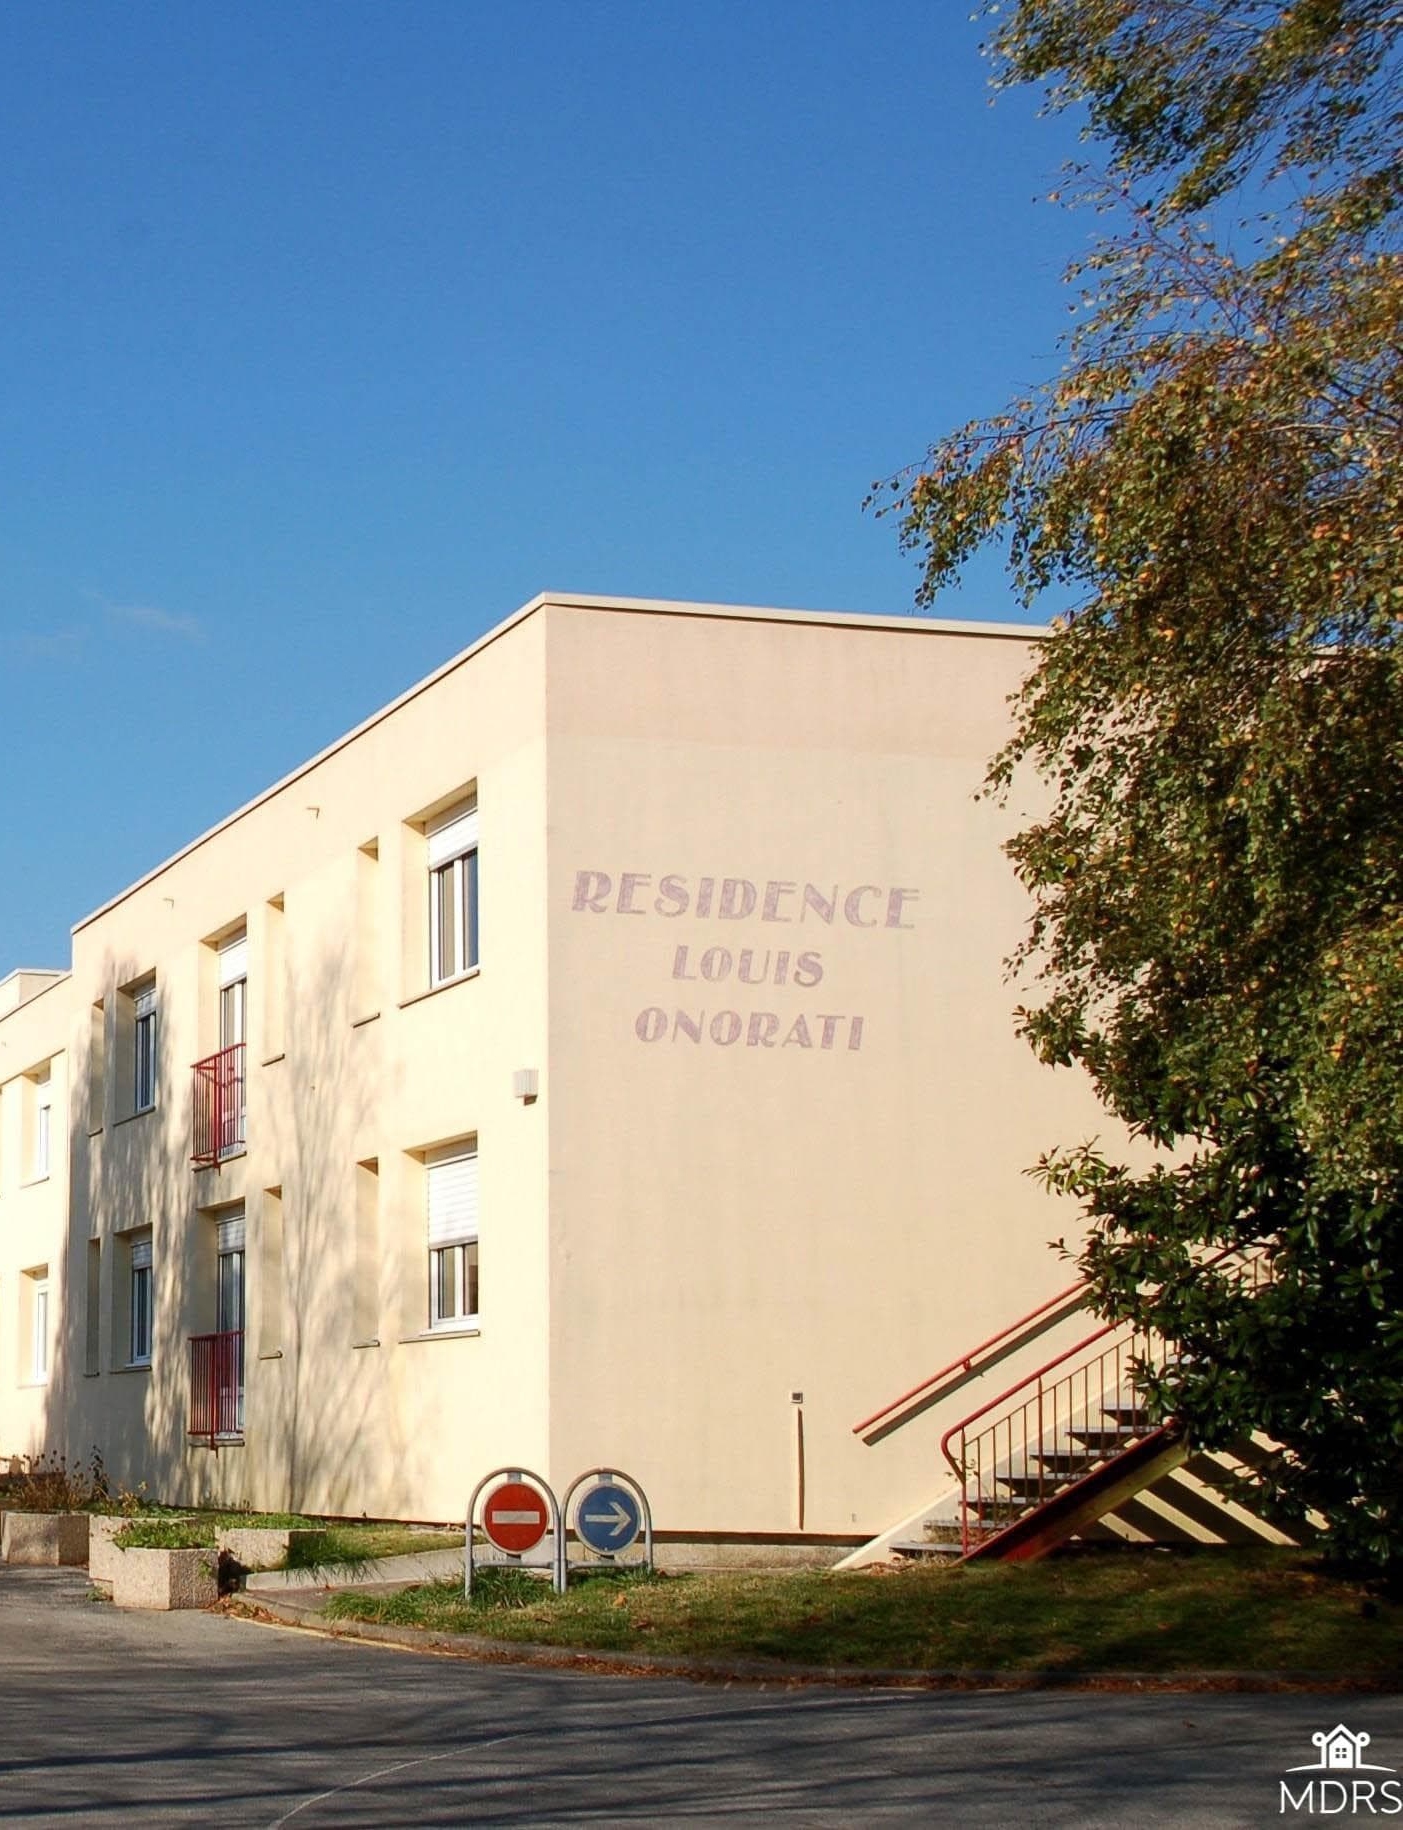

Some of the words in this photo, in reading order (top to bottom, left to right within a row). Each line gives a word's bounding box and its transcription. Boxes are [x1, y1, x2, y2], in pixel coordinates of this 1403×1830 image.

[571, 870, 920, 929] RESIDENCE
[672, 945, 824, 987] LOUIS
[634, 1006, 865, 1051] ONORATI
